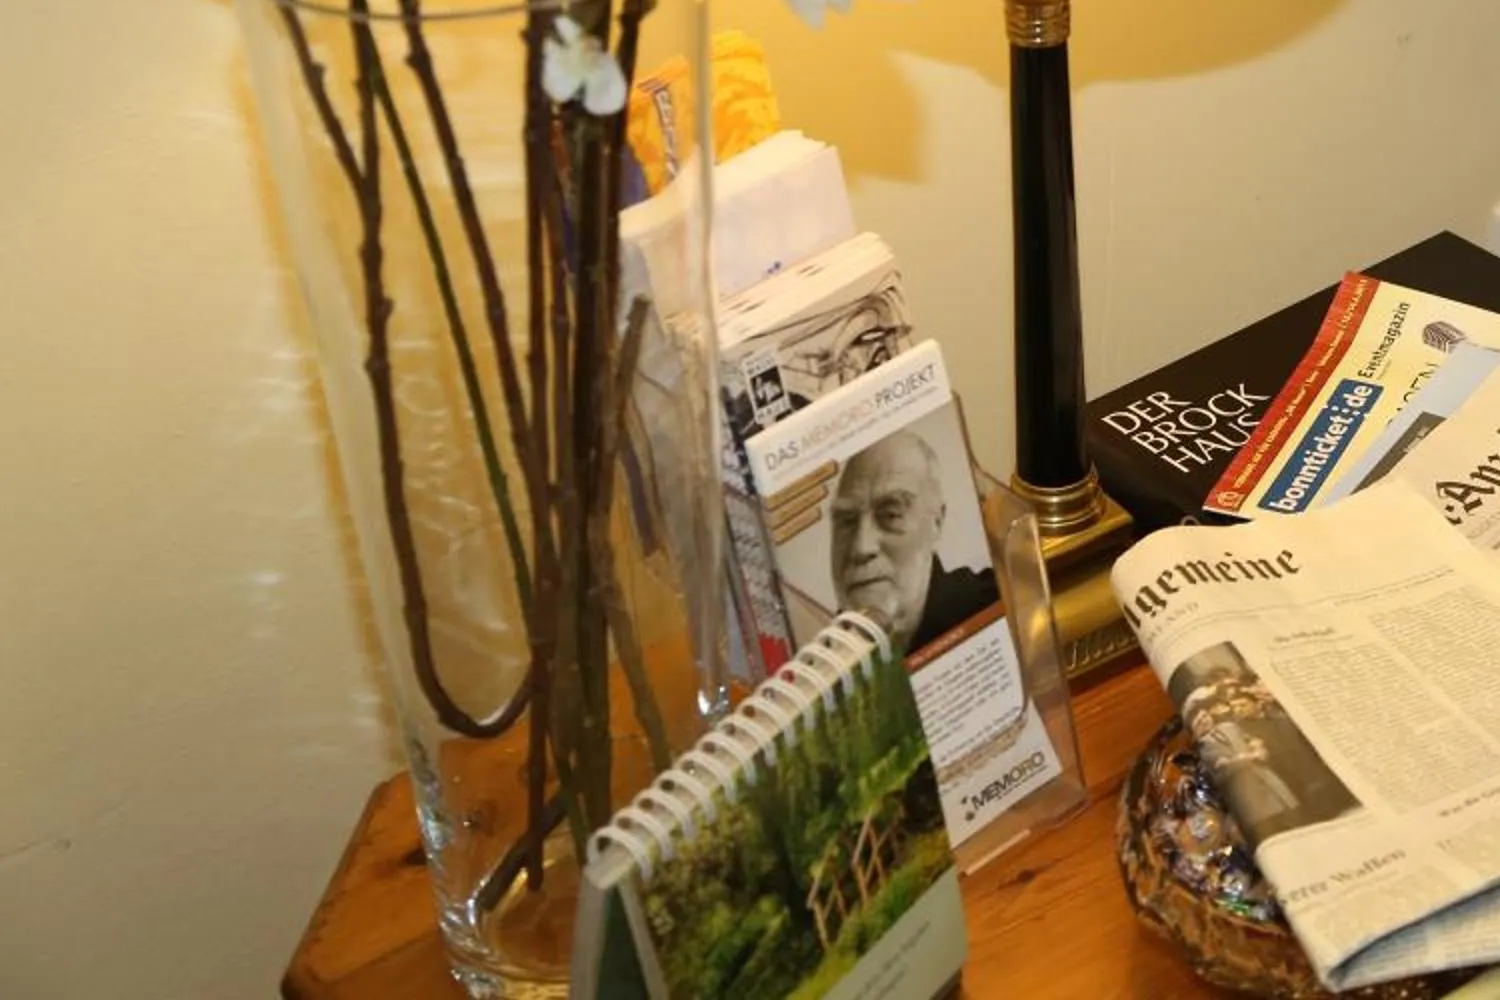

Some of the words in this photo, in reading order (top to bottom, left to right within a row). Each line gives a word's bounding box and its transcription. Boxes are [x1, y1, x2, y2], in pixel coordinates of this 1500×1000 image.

[1100, 391, 1193, 436] DER
[1131, 383, 1271, 455] BROCK
[1160, 413, 1261, 473] HAUS
